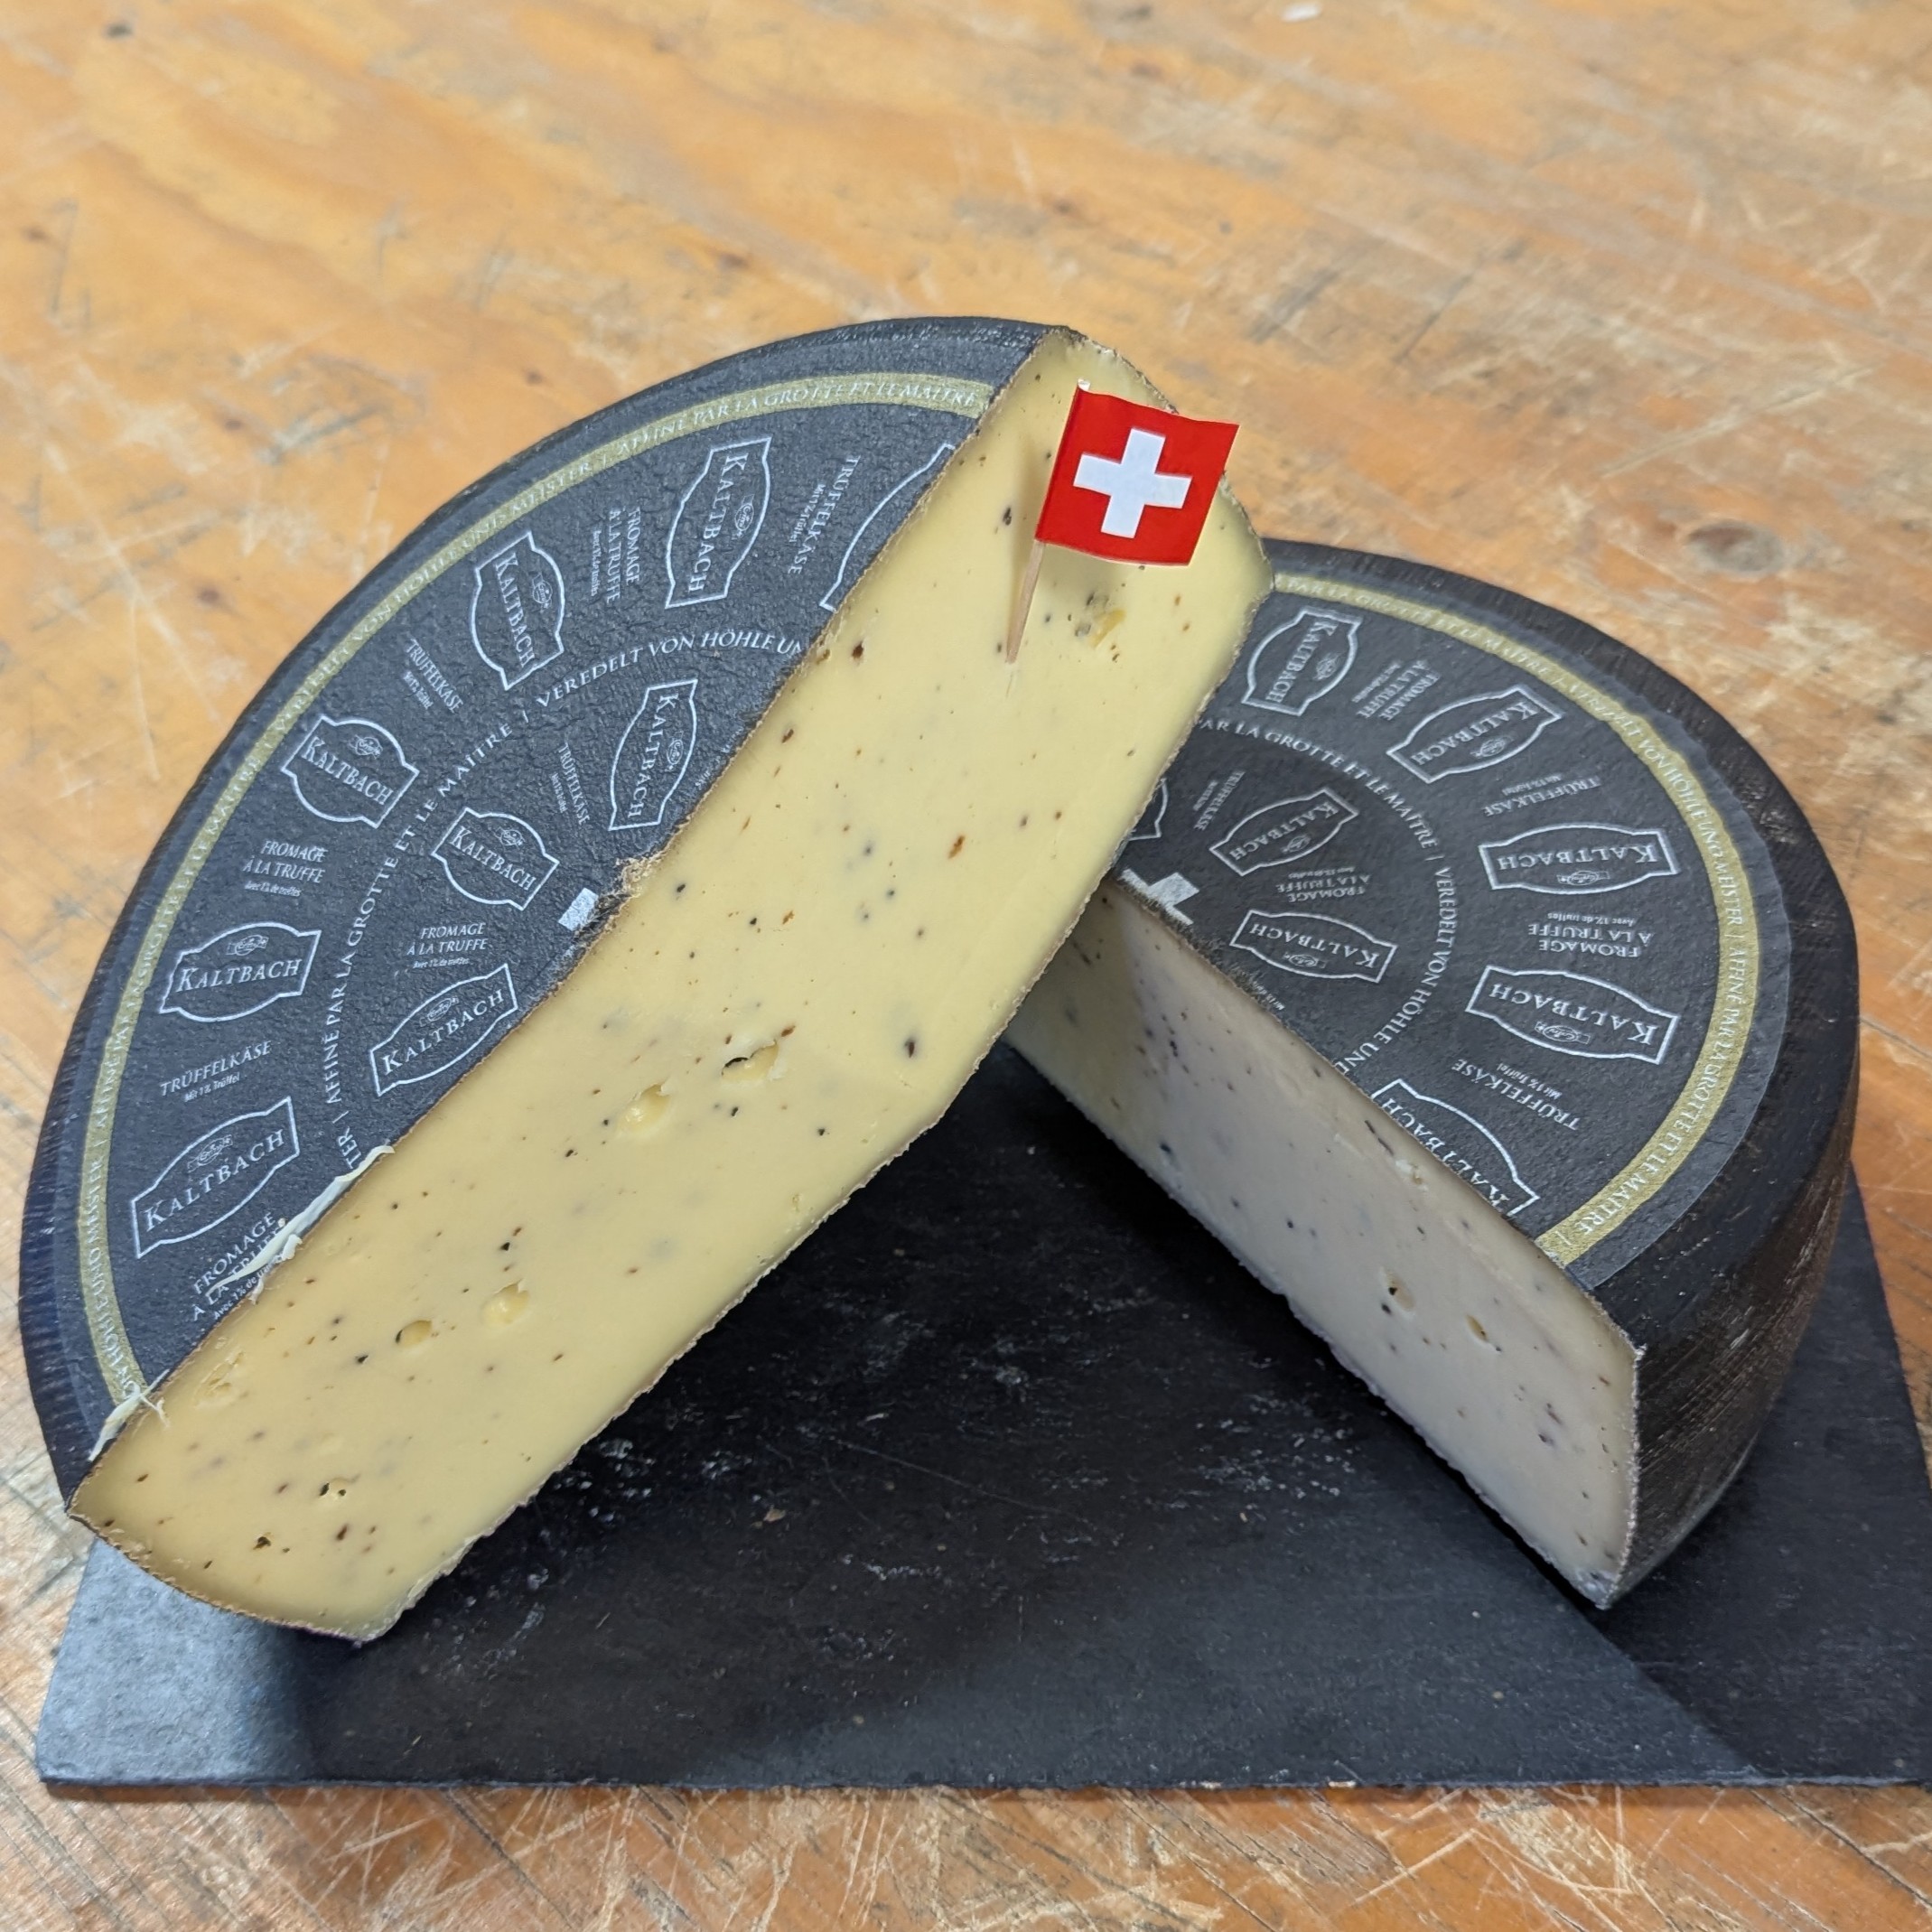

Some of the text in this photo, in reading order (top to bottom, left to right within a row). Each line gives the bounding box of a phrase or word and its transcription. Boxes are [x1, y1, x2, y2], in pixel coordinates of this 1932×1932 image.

[625, 506, 641, 585] FROMAGE
[688, 453, 749, 593] KALTBACH
[606, 541, 621, 604] TRUFFE
[495, 552, 536, 668] KALTBACH
[536, 647, 644, 706] VEREDELT
[649, 633, 695, 657] VON
[701, 629, 775, 650] HÖHLE
[1266, 620, 1339, 704] KALTBACH
[1356, 684, 1405, 719] TRUFFE
[1378, 672, 1441, 721] FROMAGE
[628, 694, 679, 818] KALTBACH
[1235, 722, 1261, 739] LA
[1265, 731, 1345, 768] GROTTE
[1343, 761, 1371, 779] ET
[1365, 776, 1389, 795] LE
[1411, 701, 1539, 765] KALTBACH
[301, 736, 394, 806] KALTBACH
[395, 820, 416, 852] ET
[415, 798, 438, 832] LE
[1228, 800, 1339, 861] KALTBACH
[254, 859, 272, 875] LA
[274, 861, 326, 883] TRUFFE
[260, 840, 329, 863] FROMAGE
[452, 826, 537, 892] KALTBACH
[1498, 844, 1658, 871] KALTBACH
[347, 856, 399, 947] GROTTE
[1275, 878, 1335, 893] TRUFFE
[1287, 886, 1366, 902] FROMAGE
[1337, 874, 1357, 886] LA
[420, 921, 487, 940] FROMAGE
[1434, 866, 1459, 948] VEREDELT
[1528, 923, 1604, 941] TRUFFE
[418, 942, 434, 956] LA
[439, 938, 490, 953] TRUFFE
[1249, 922, 1380, 969] KALTBACH
[1538, 939, 1641, 958] FROMAGE
[1608, 929, 1635, 943] LA
[176, 957, 303, 993] KALTBACH
[335, 951, 357, 978] LA
[1421, 950, 1452, 988] VON
[326, 983, 348, 1025] PAR
[1373, 988, 1433, 1044] HÖHLE
[1489, 982, 1659, 1046] KALTBACH
[382, 989, 505, 1076] KALTBACH
[159, 1041, 272, 1097] TRÜFFELKÄSE
[1451, 1059, 1581, 1130] TRÜFFELKÄSE
[1496, 1062, 1530, 1084] Trüffel
[144, 1128, 285, 1233] KALTBACH
[192, 1211, 275, 1295] FROMAGE
